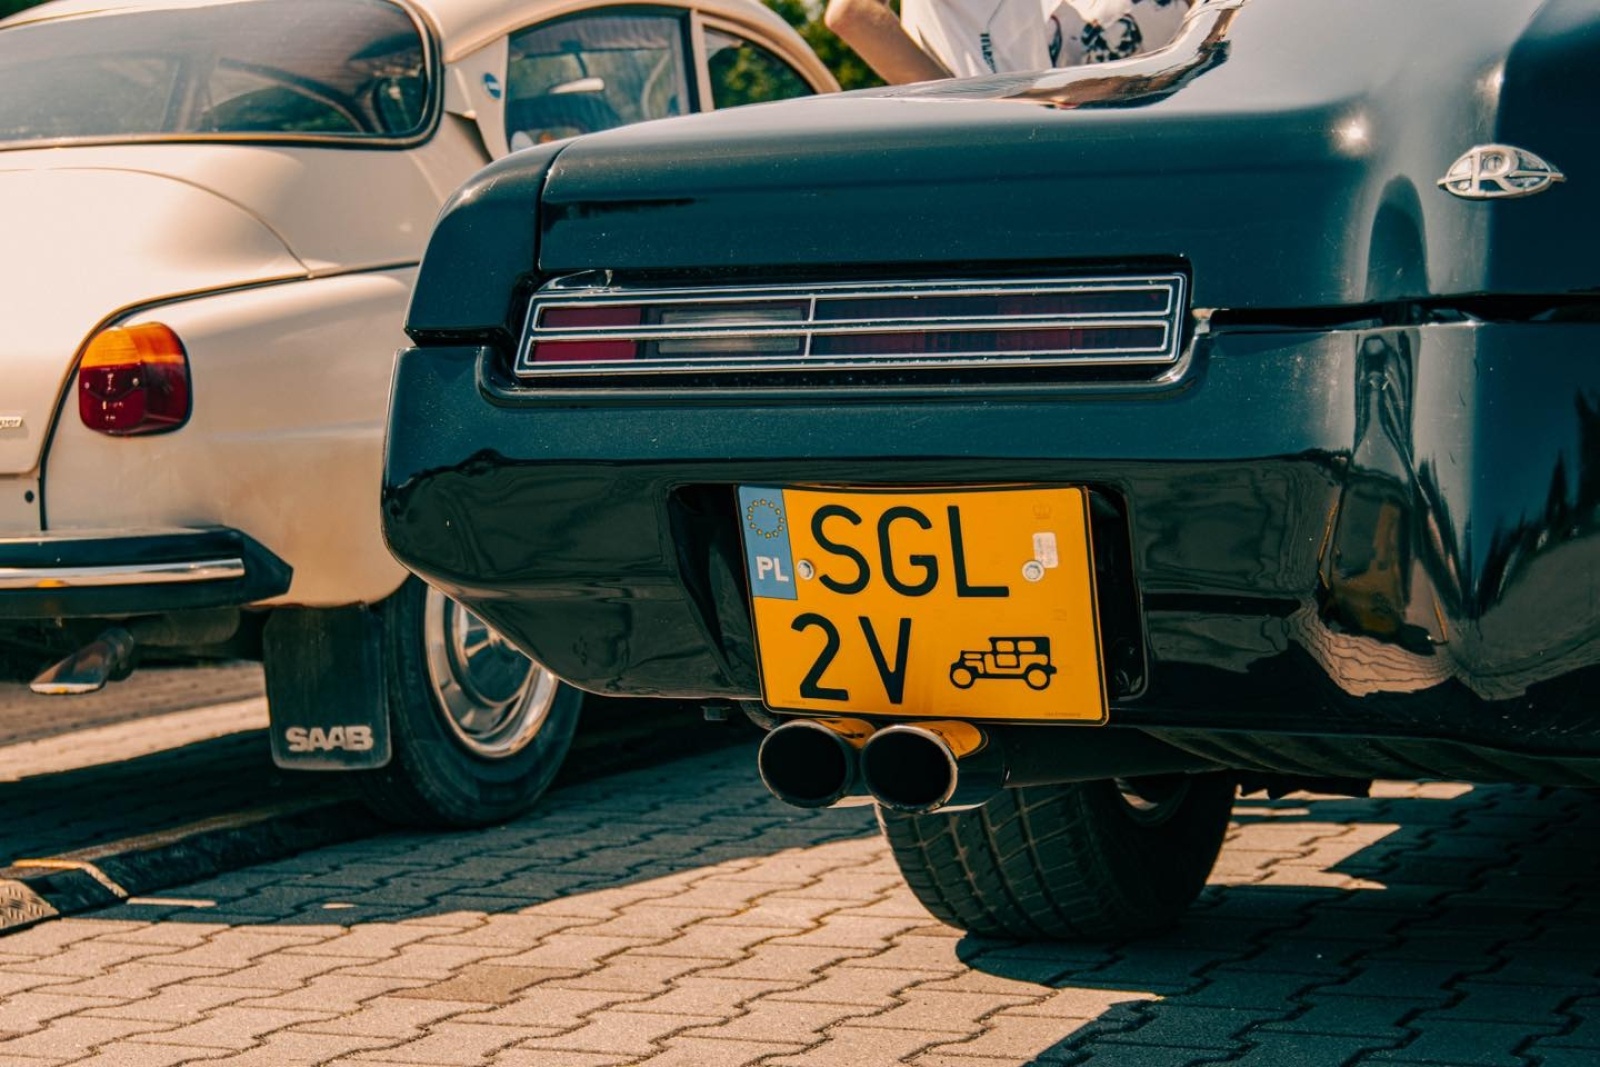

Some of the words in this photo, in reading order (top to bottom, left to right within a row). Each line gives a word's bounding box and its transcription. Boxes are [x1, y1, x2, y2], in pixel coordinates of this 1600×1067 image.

[756, 556, 789, 582] PL
[810, 504, 1010, 598] SGL
[790, 612, 912, 705] 2V
[285, 725, 374, 752] SAAB
